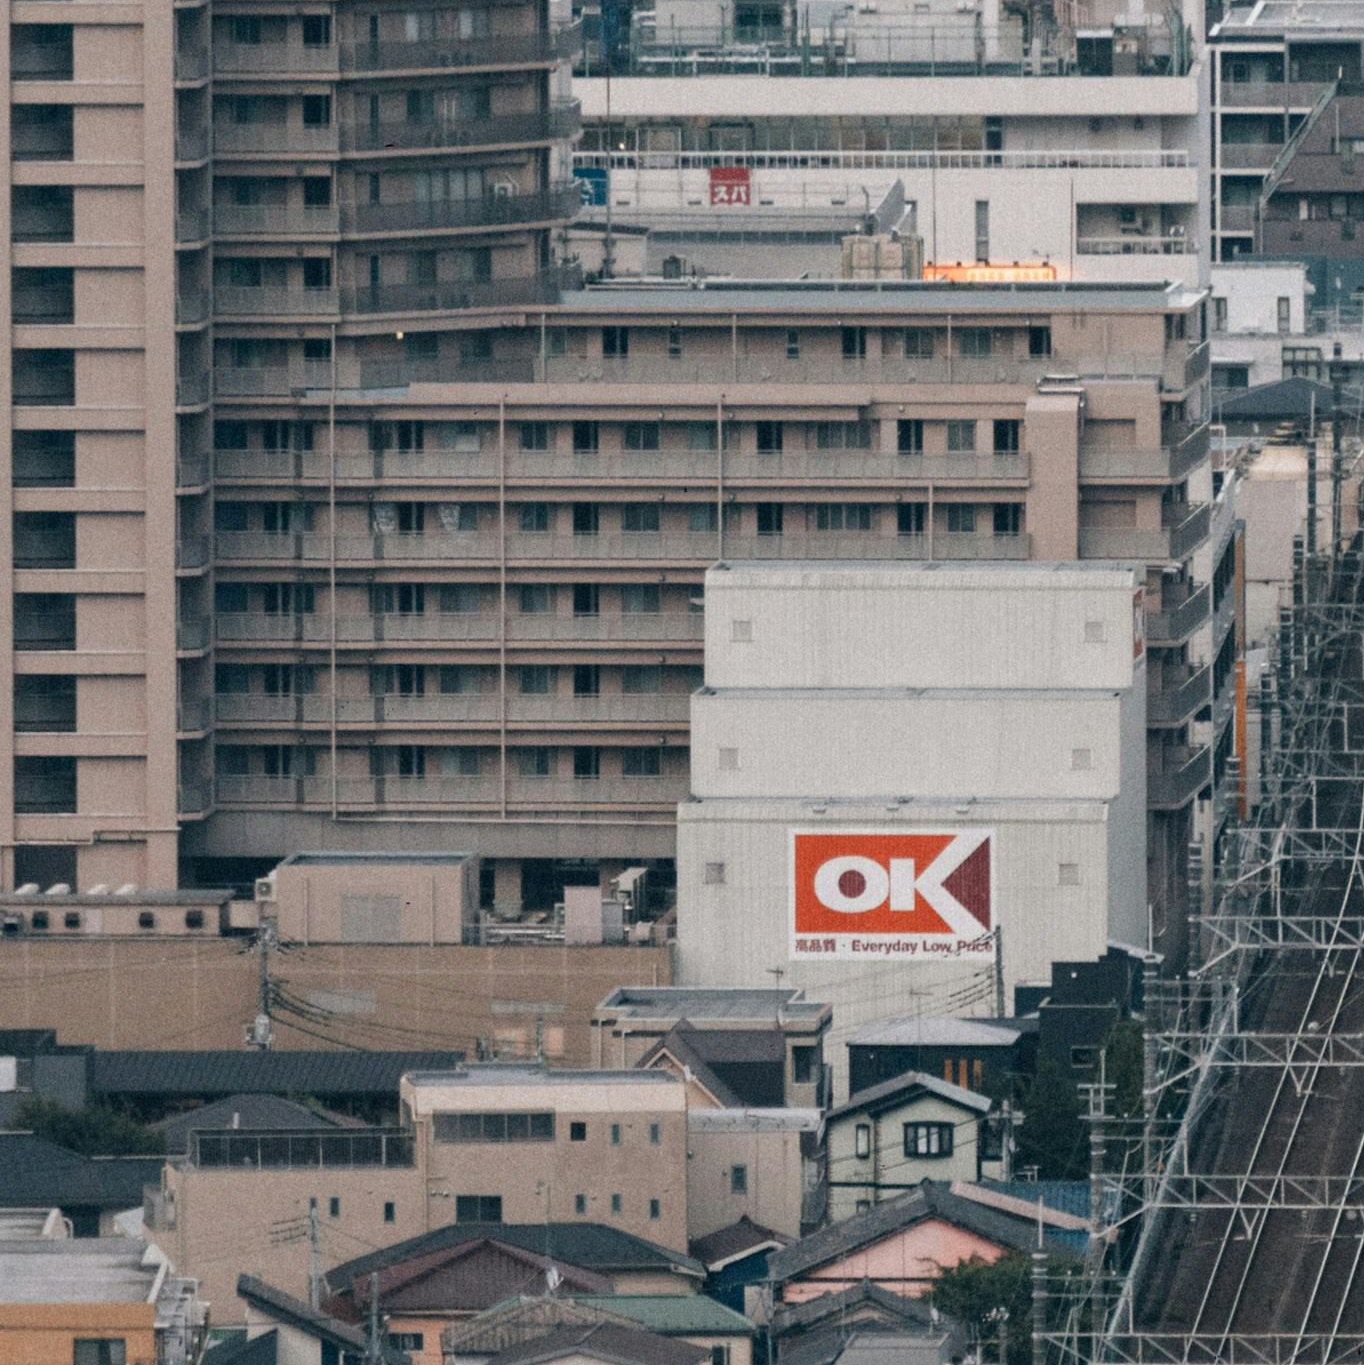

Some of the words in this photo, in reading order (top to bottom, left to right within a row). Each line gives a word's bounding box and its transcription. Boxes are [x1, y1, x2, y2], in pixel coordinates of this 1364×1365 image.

[814, 833, 991, 935] OK
[851, 939, 918, 955] Everyday
[922, 939, 951, 953] Low
[956, 938, 993, 953] Price
